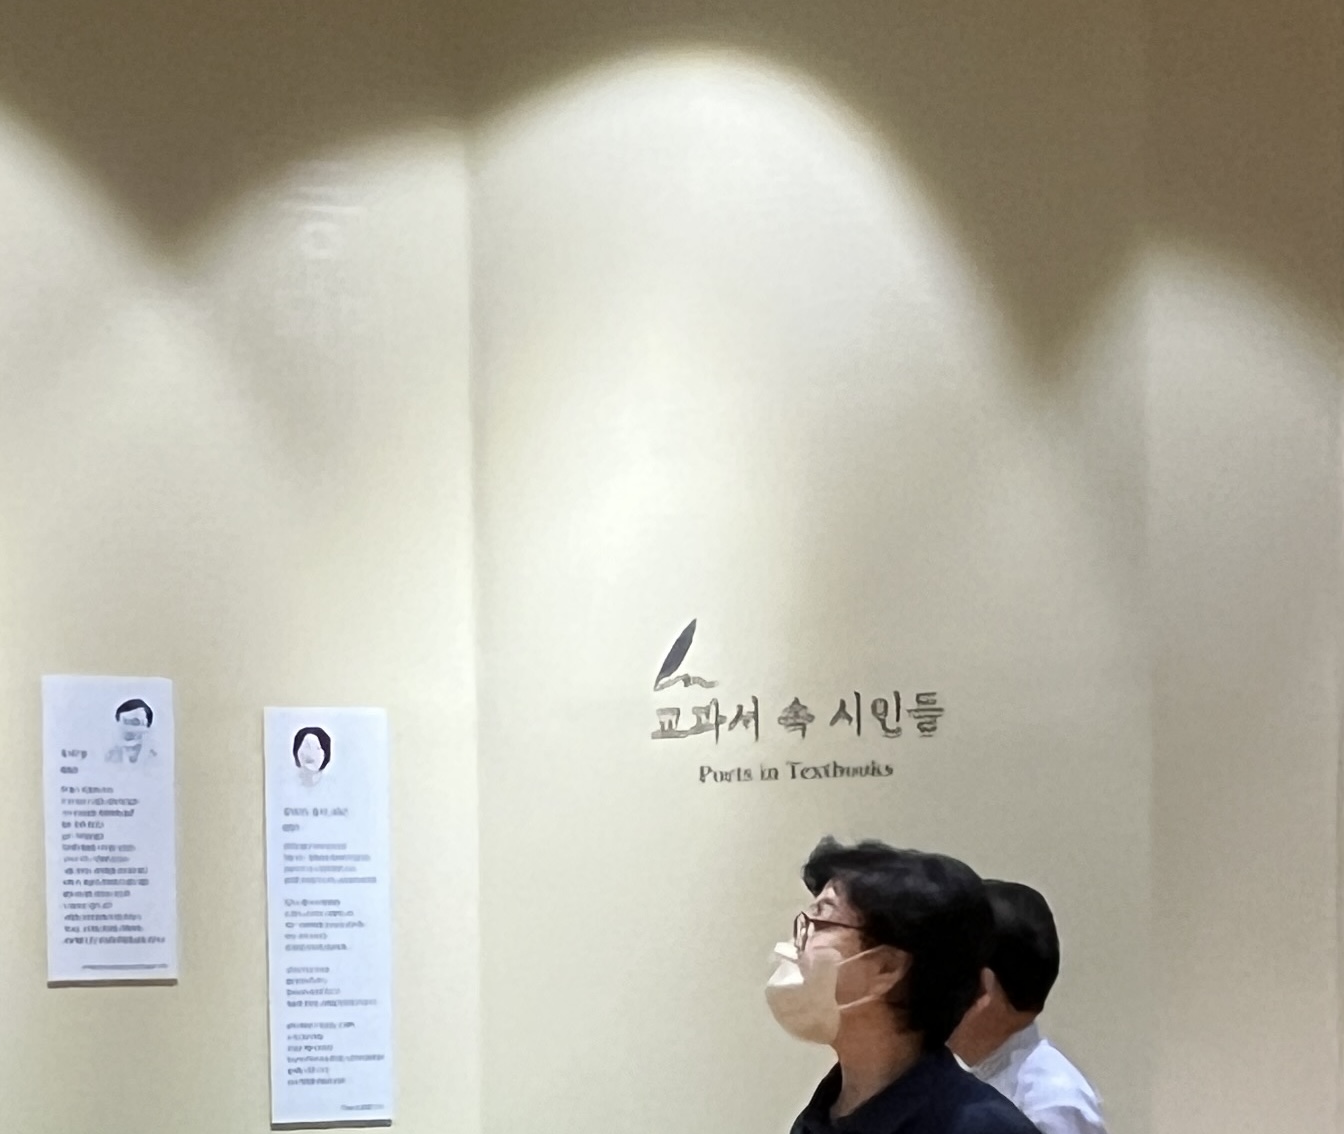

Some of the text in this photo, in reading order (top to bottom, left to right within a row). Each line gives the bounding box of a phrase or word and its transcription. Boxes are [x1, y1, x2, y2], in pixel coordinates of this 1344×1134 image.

[650, 695, 759, 745] 교과서
[829, 690, 945, 739] 시인들
[760, 761, 780, 781] in
[786, 759, 895, 780] Textbooks
